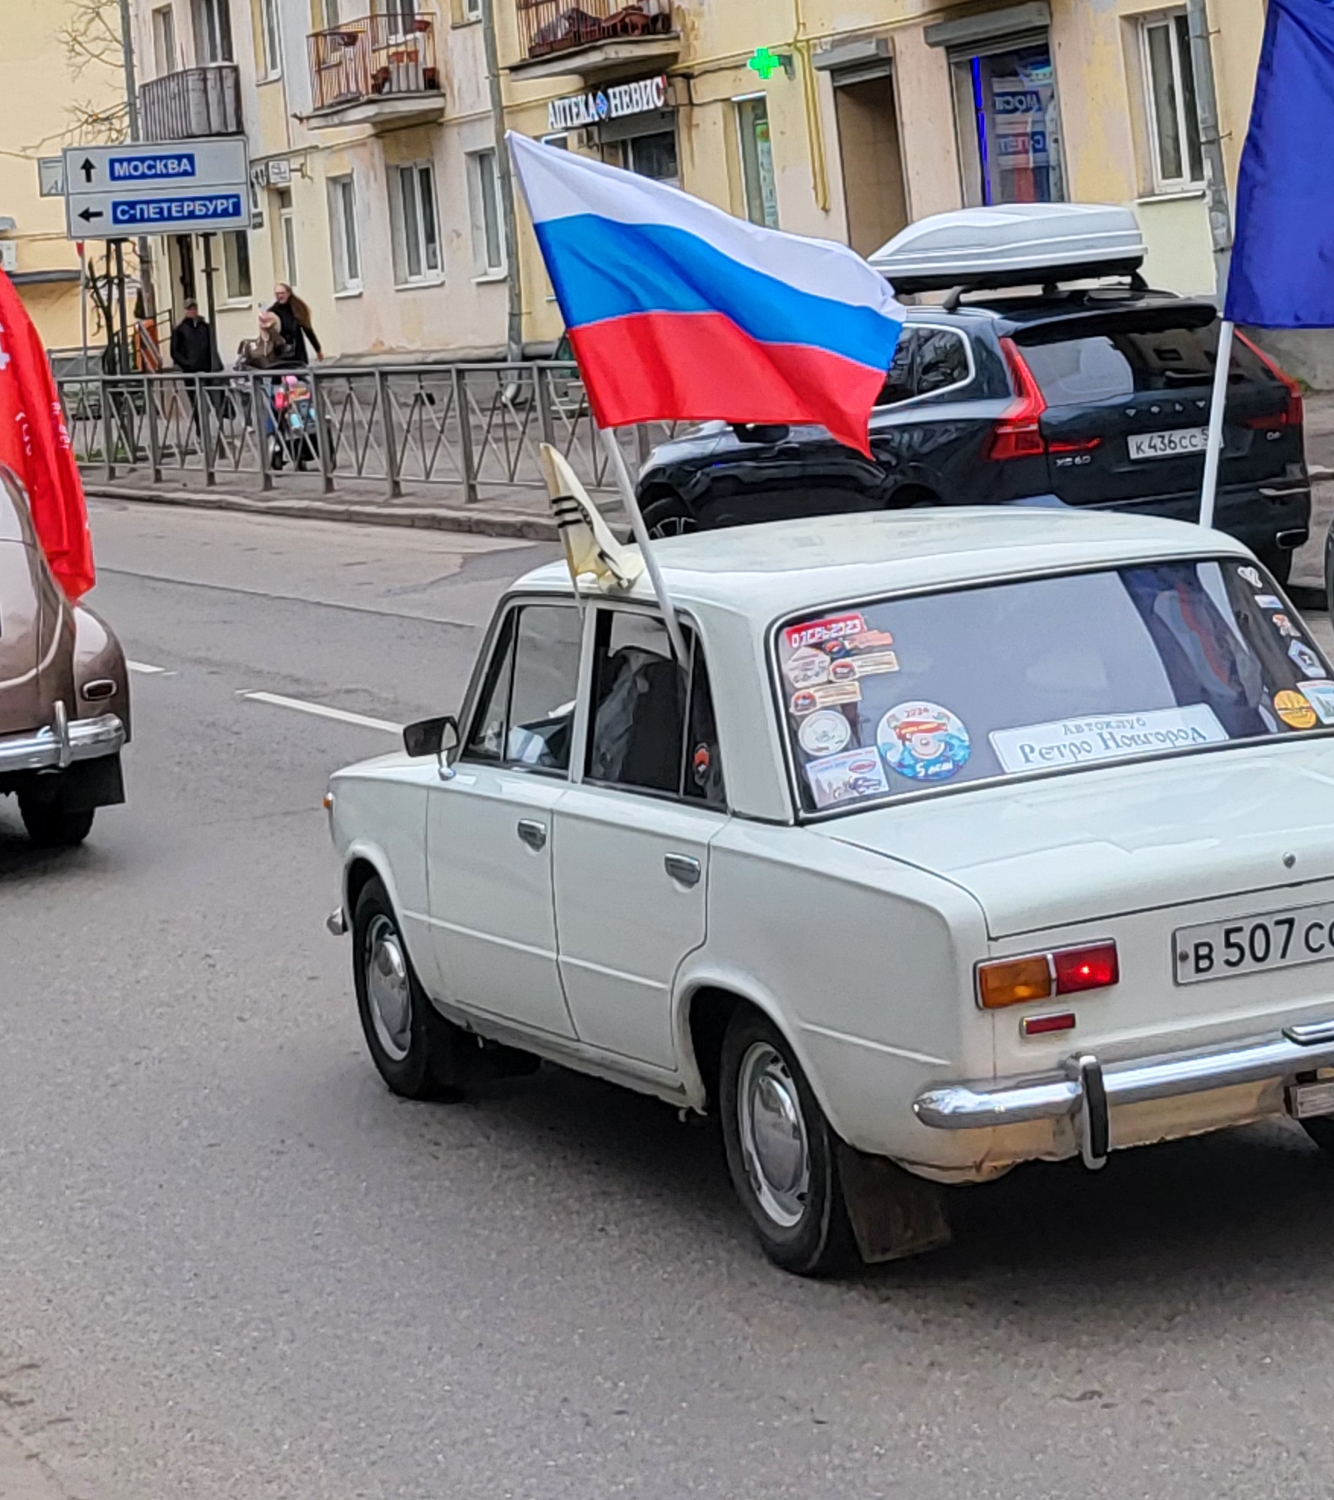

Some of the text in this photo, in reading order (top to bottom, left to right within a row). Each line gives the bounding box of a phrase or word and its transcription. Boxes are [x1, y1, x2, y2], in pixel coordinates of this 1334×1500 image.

[548, 76, 666, 130] АПТЕКА НЕВИС
[113, 157, 193, 177] МОСКВА
[117, 197, 238, 220] С-ПЕТЕРБУРГ
[1125, 401, 1207, 417] VOLV
[1135, 431, 1199, 455] К436СС
[1063, 716, 1147, 736] Автоклуб
[1019, 726, 1208, 764] Ретро Новгород
